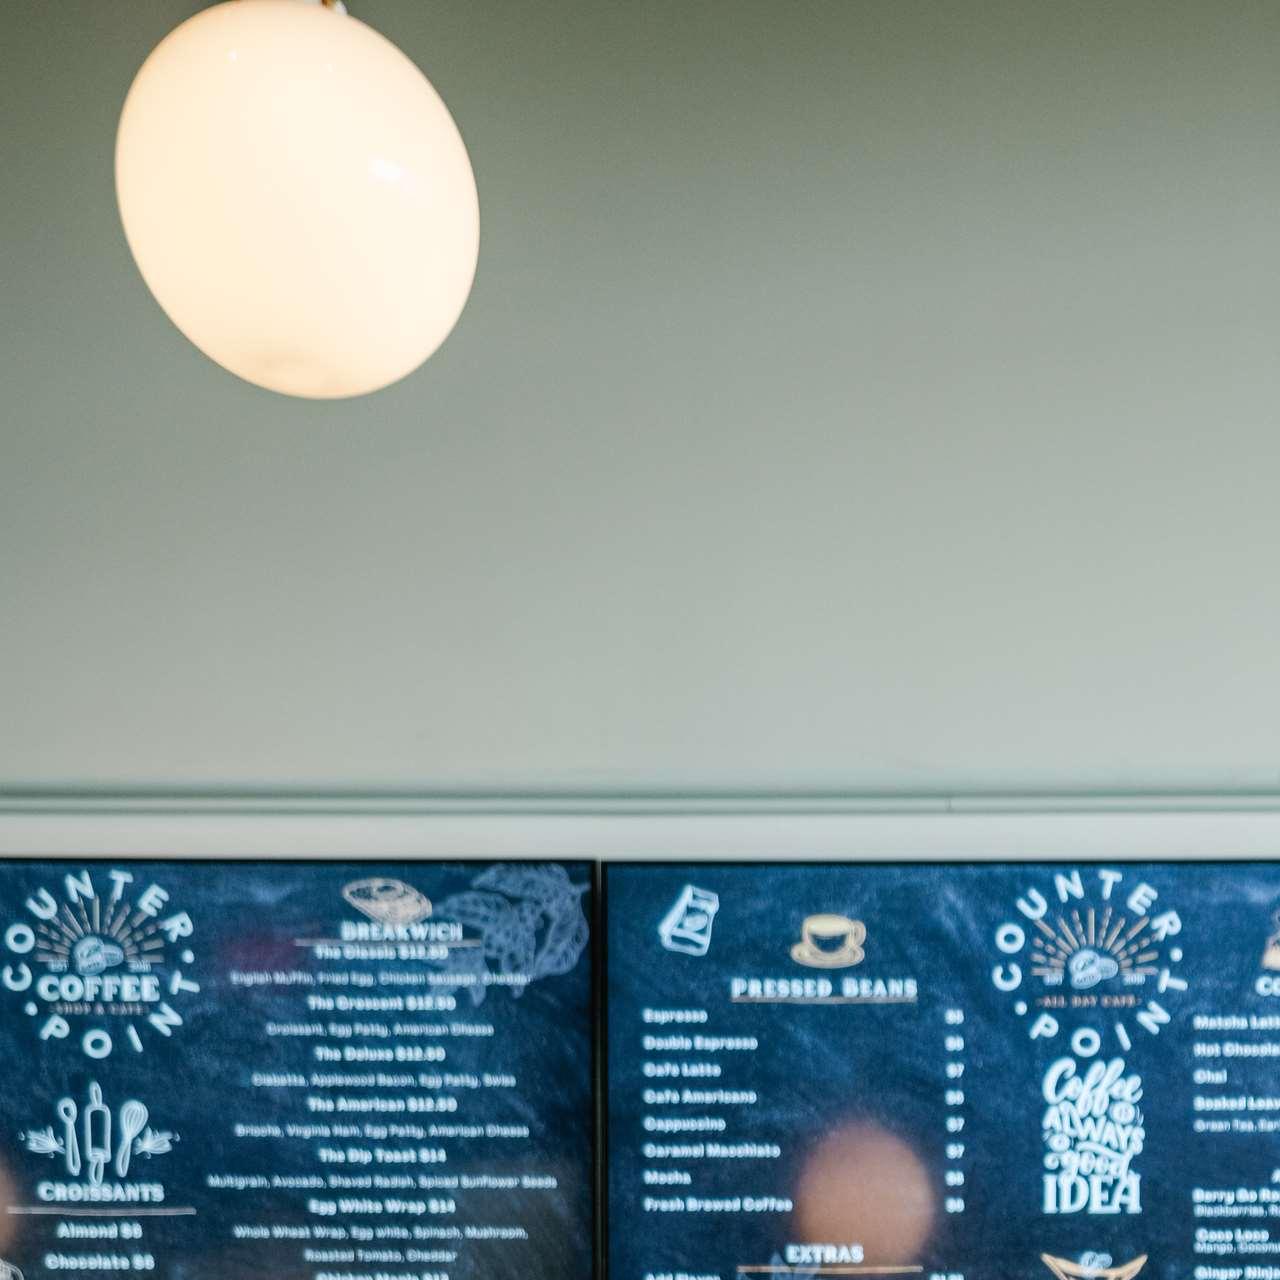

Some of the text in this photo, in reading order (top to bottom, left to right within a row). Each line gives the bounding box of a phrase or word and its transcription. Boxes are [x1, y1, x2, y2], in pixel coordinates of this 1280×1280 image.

[3, 869, 194, 992] COUNTER
[342, 921, 463, 941] BREAKWICH
[992, 869, 1182, 991] COUNTER
[37, 974, 160, 1001] COFFEE
[732, 978, 917, 998] PRESSED BEANS
[1042, 1057, 1143, 1118] Coffee
[38, 1182, 165, 1202] CROISSANTS
[1042, 1173, 1142, 1214] IDEA
[787, 1244, 863, 1262] EXTRAS
